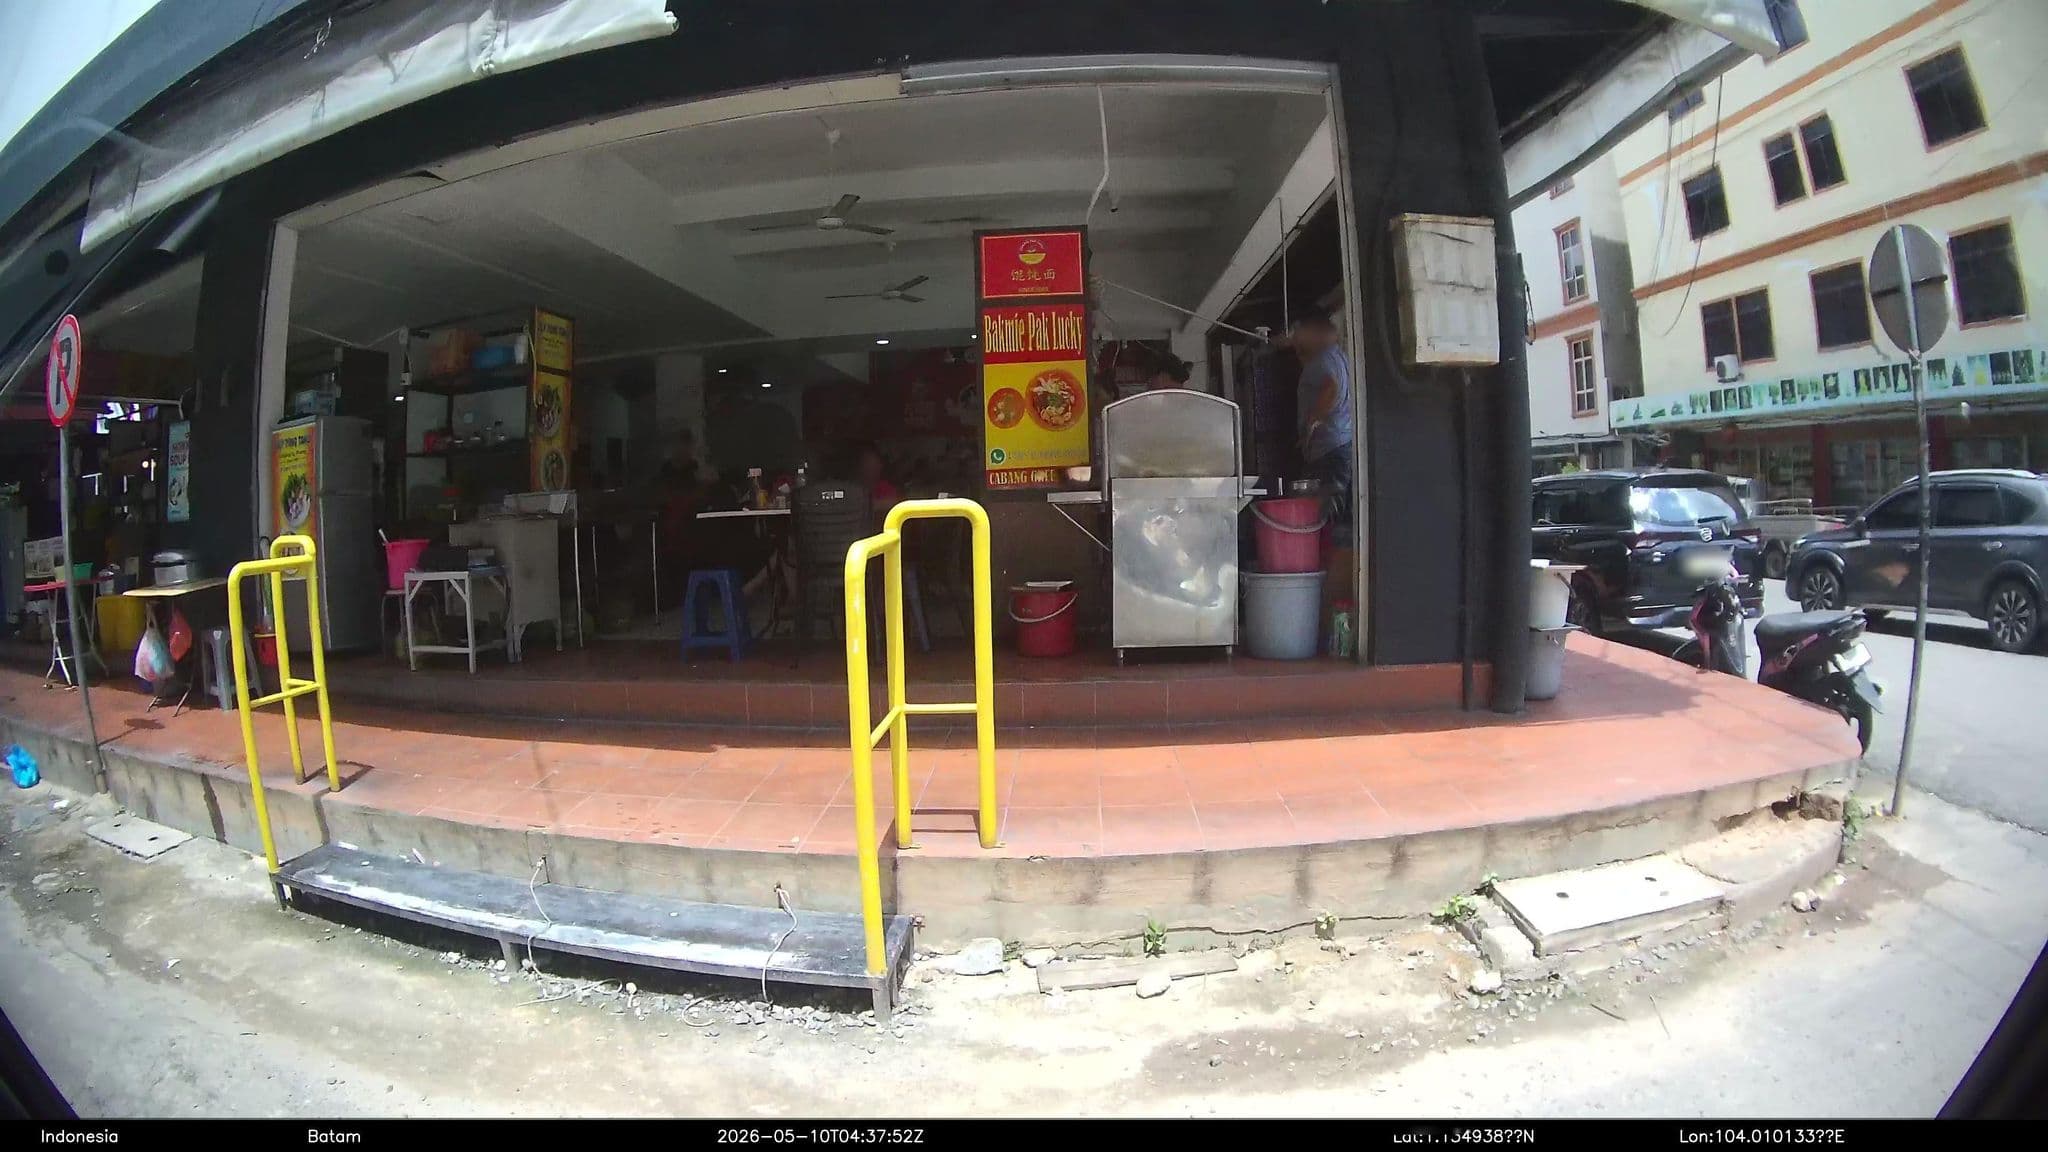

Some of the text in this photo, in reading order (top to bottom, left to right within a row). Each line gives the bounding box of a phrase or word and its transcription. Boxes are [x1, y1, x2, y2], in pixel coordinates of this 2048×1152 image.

[984, 310, 1083, 355] Bakmie Pak Lucky
[989, 470, 1028, 485] CABANG
